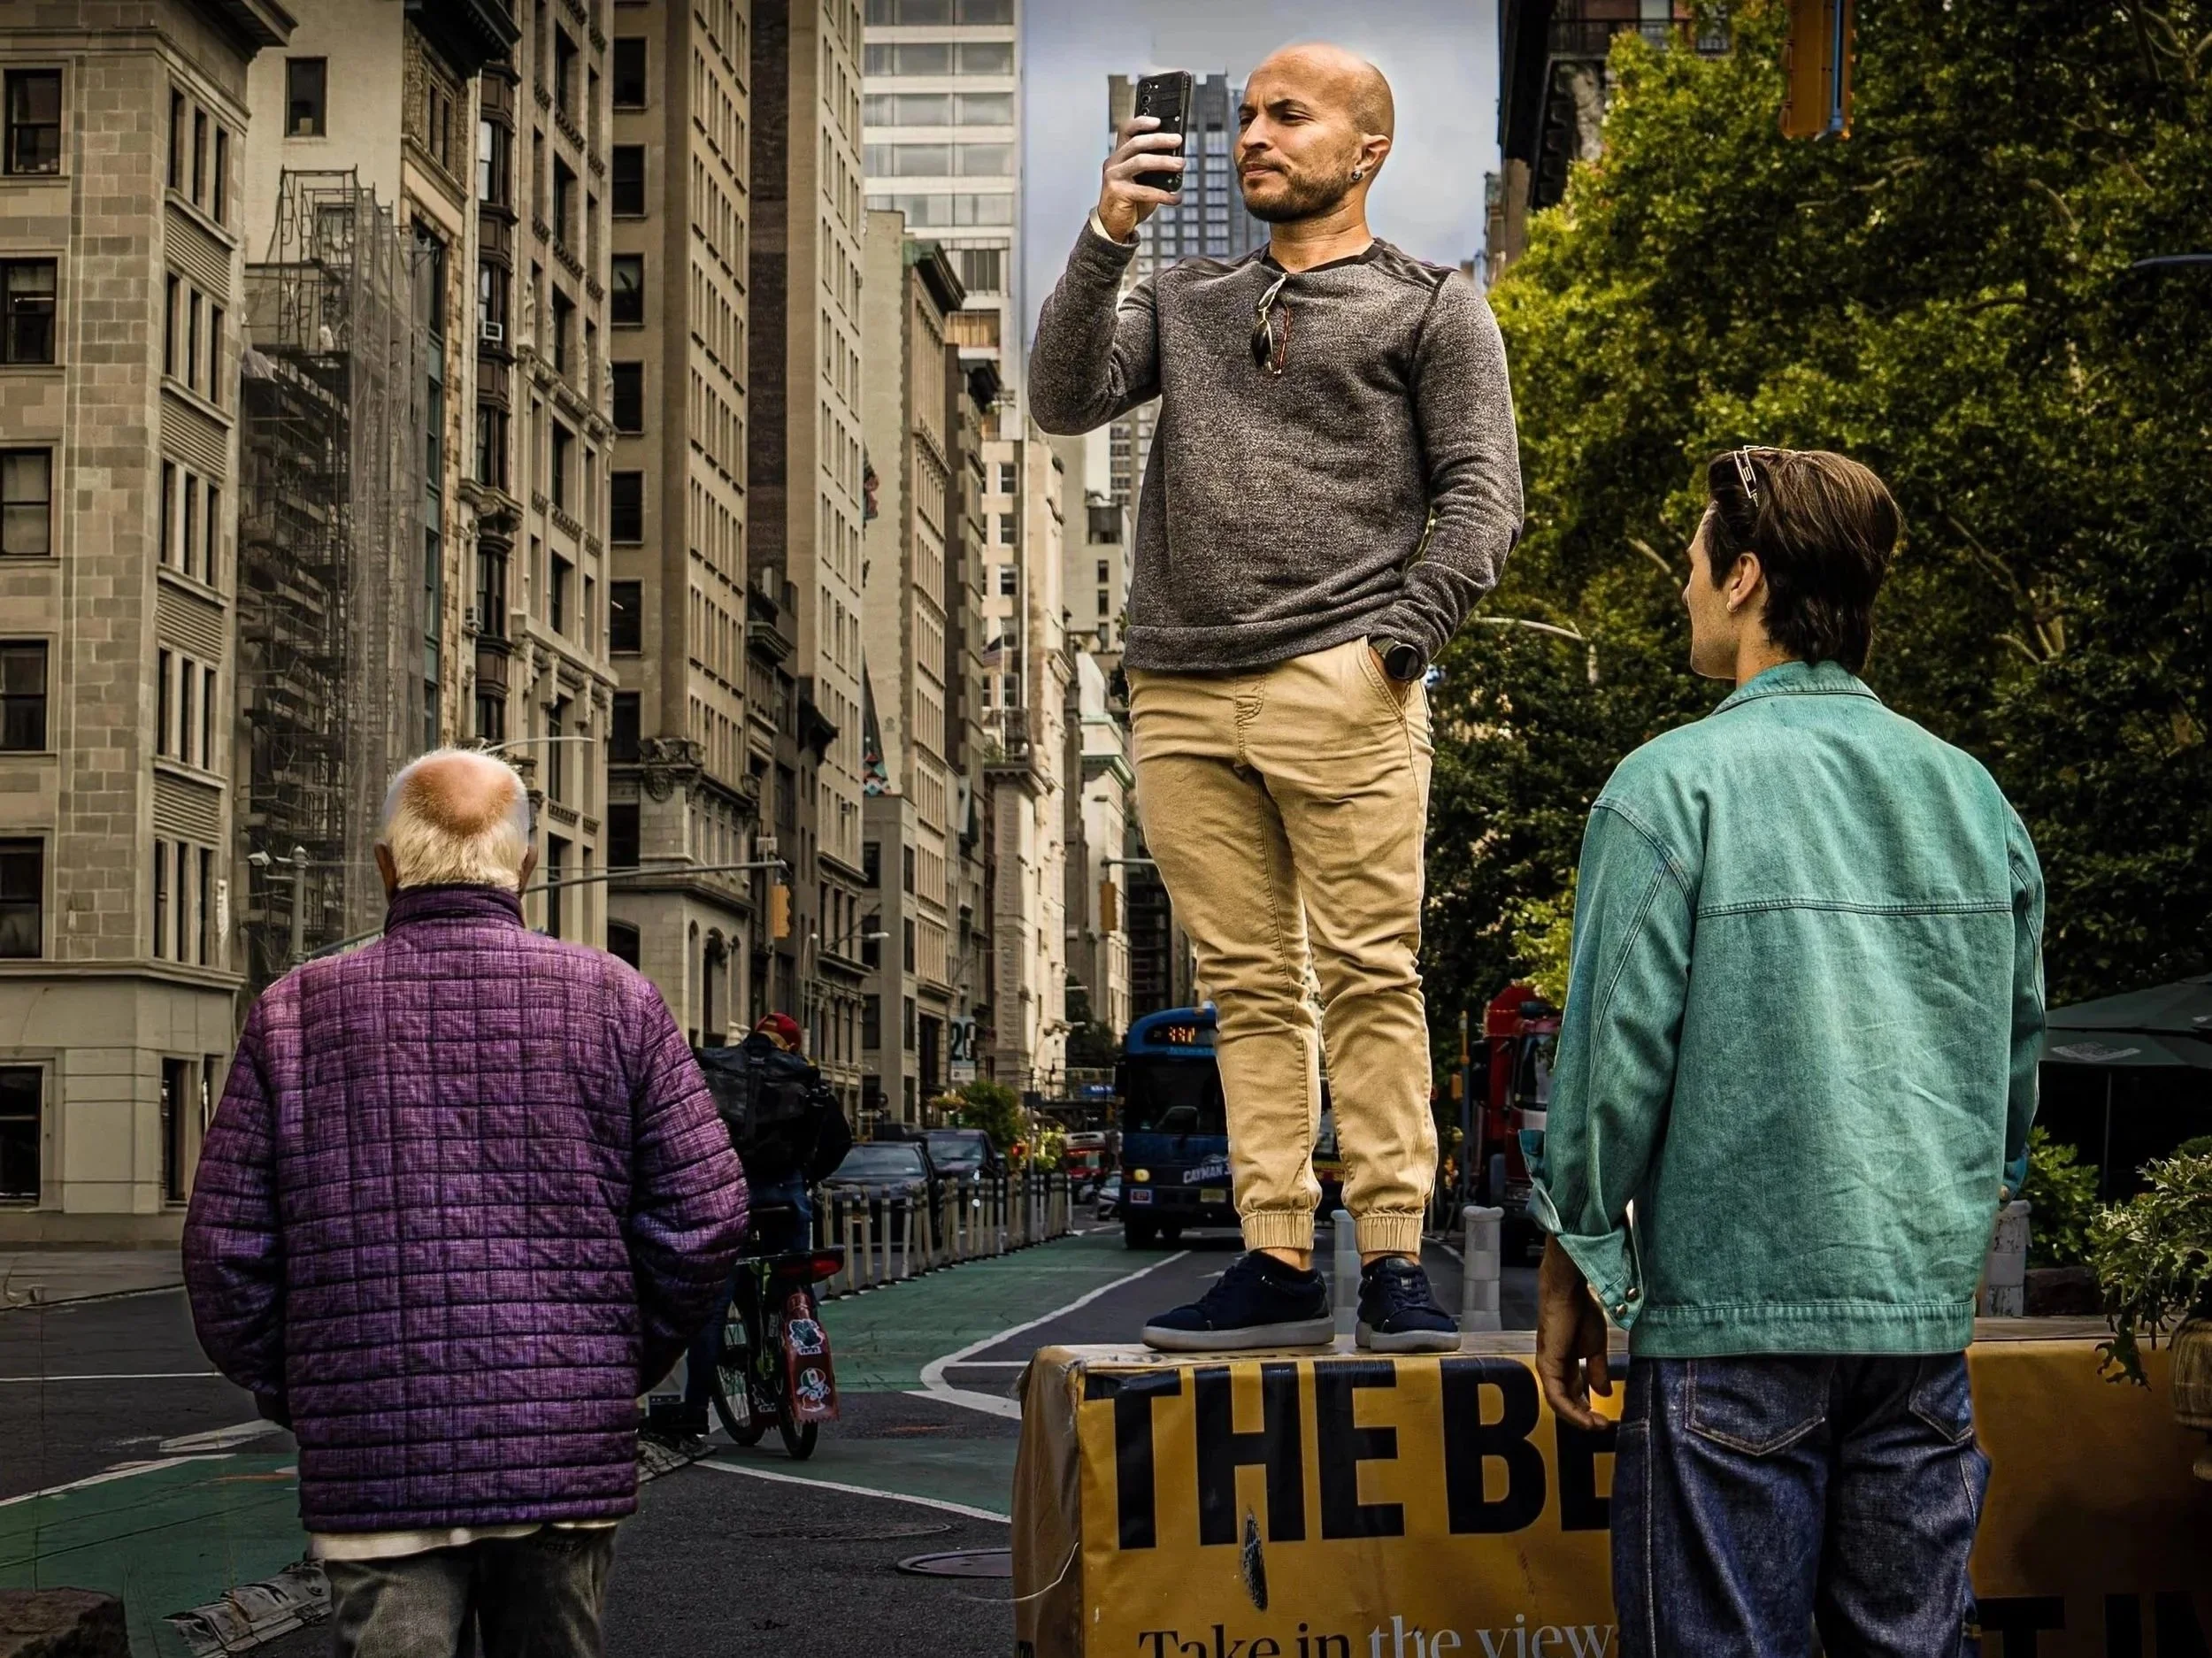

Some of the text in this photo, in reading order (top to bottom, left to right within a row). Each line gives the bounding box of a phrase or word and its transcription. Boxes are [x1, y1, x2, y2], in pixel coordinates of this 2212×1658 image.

[1183, 1163, 1224, 1185] CAYMAN
[1085, 1356, 1626, 1550] THE BE
[1139, 1613, 1614, 1658] Take in the view
